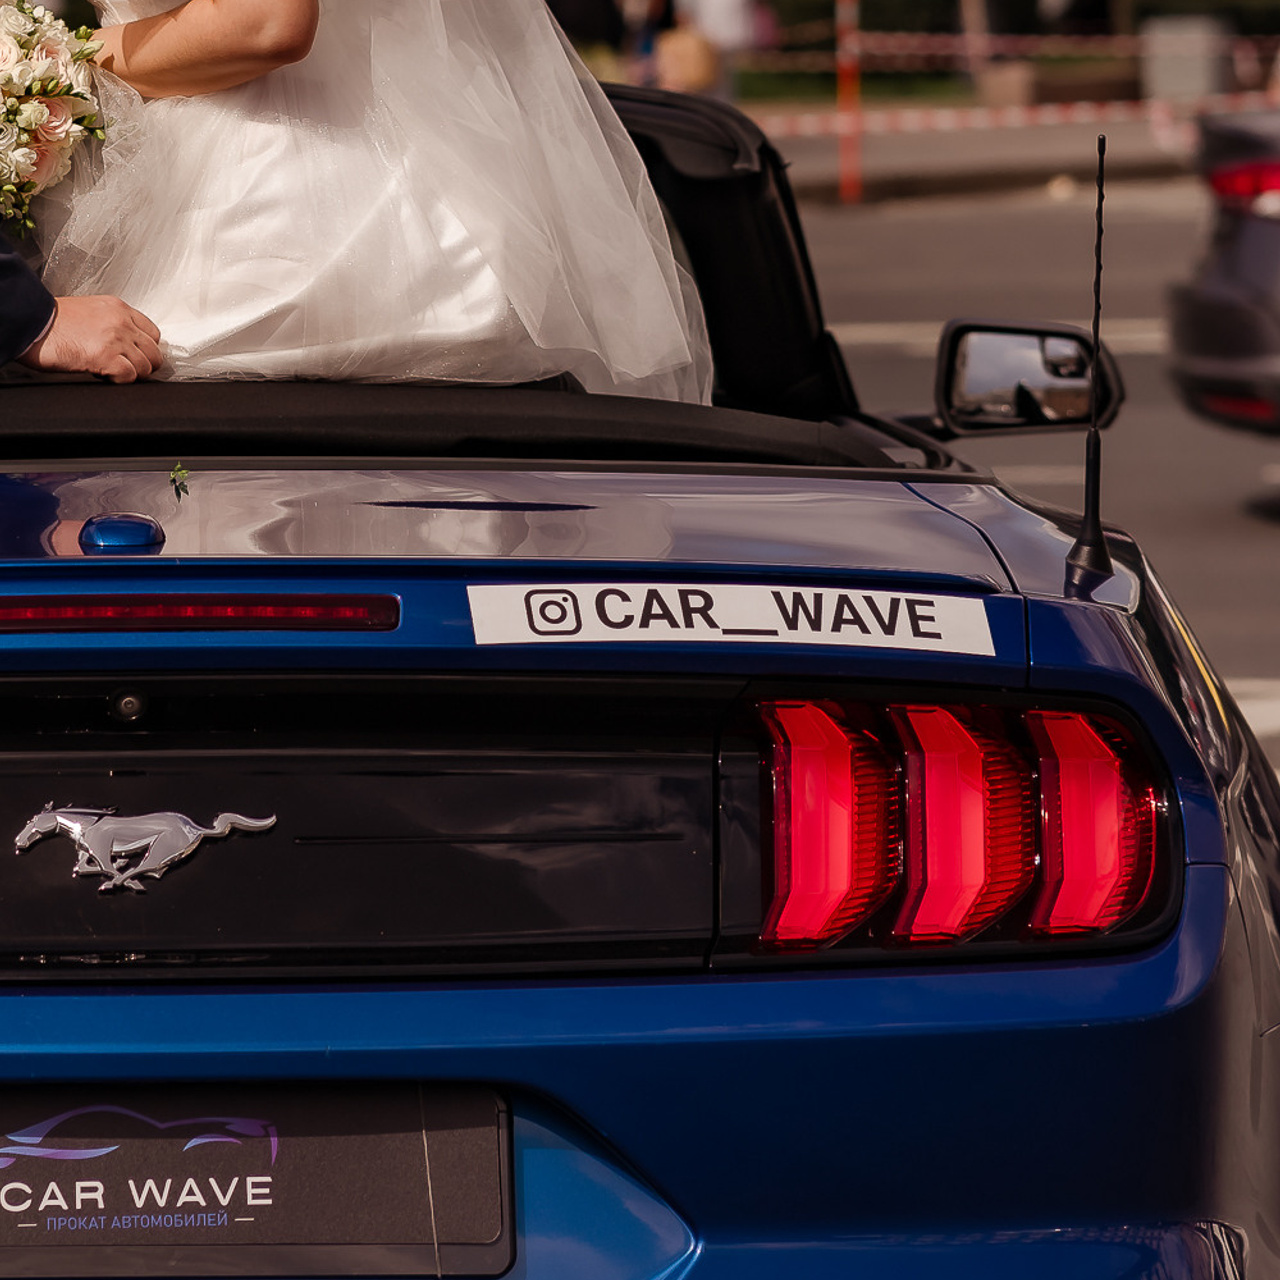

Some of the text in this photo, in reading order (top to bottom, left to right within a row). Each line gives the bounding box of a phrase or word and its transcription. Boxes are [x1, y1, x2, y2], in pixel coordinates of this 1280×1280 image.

[0, 1176, 273, 1212] CAR WAVE
[46, 1210, 228, 1231] ПРОКАТ АВТОМОБИЛЕЙ
